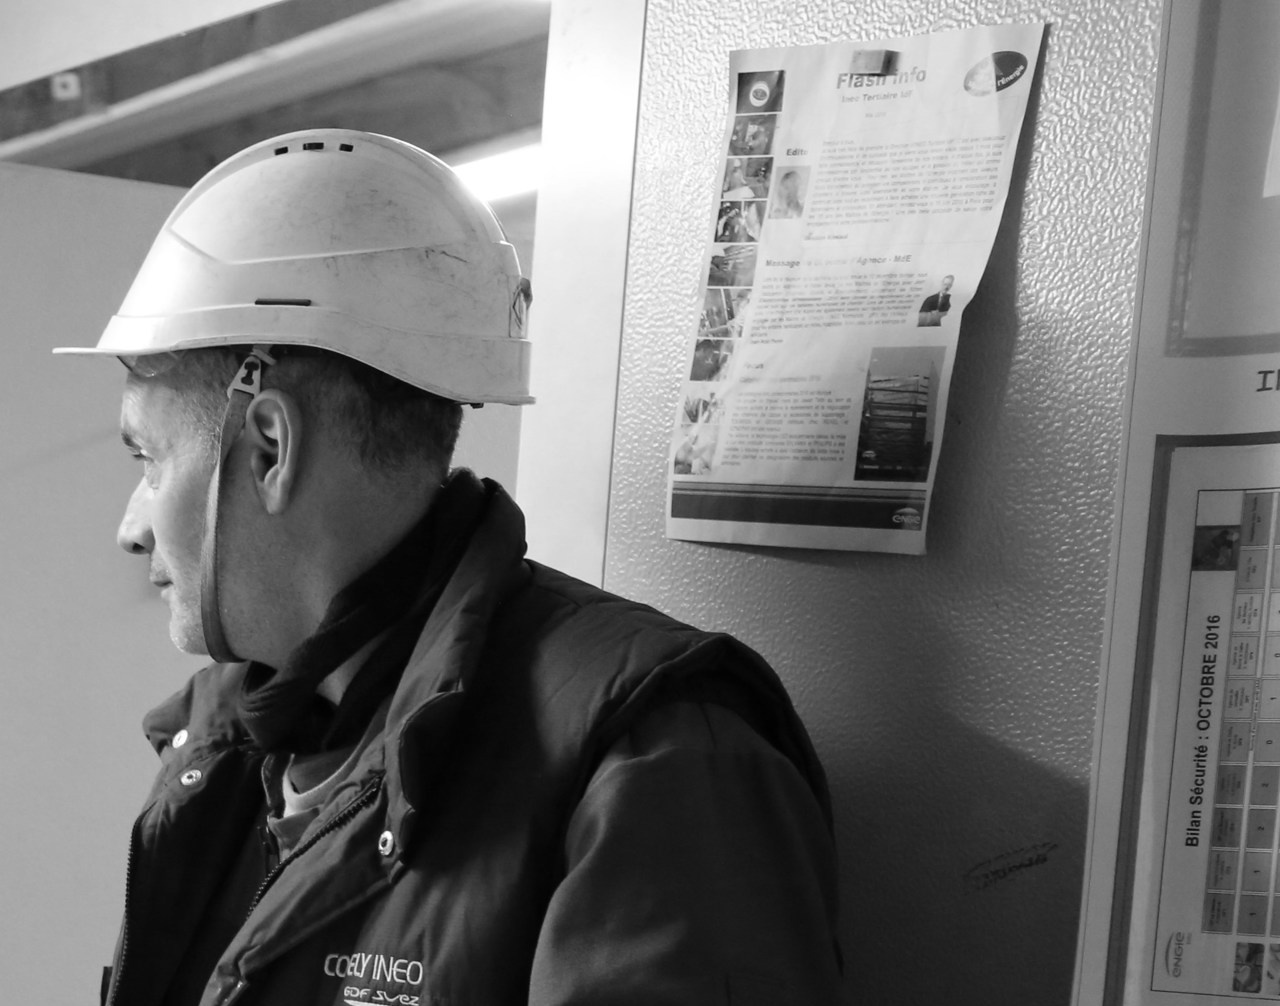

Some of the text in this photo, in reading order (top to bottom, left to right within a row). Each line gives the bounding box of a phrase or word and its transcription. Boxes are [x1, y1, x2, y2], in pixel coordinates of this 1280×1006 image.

[1204, 614, 1221, 649] 2016
[1196, 654, 1217, 731] OCTOBRE
[1189, 744, 1209, 806] Sécurité
[1185, 810, 1202, 847] Bilan
[372, 954, 423, 985] INEO
[343, 986, 371, 998] GDF
